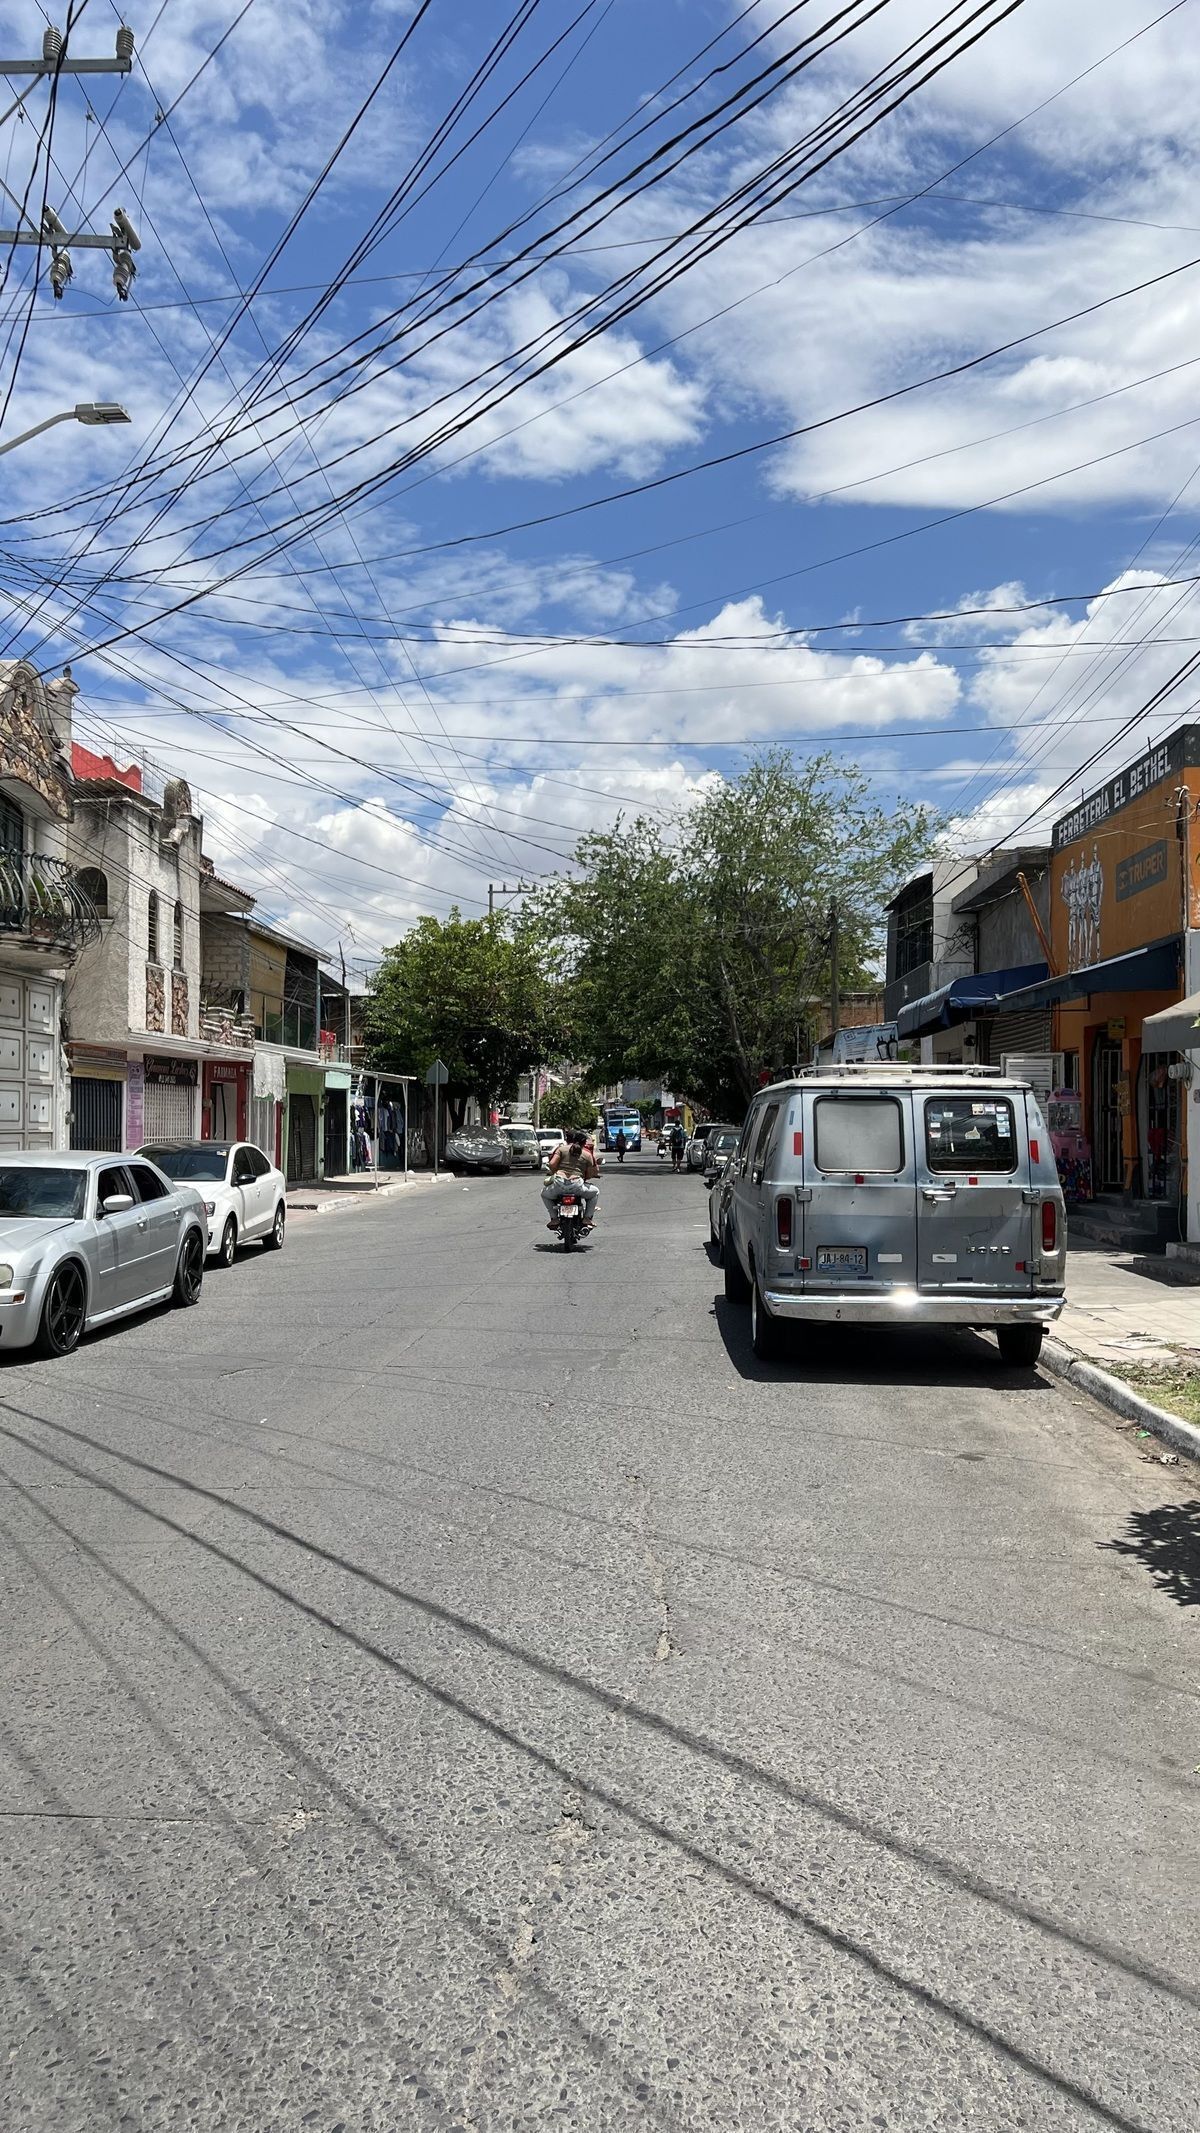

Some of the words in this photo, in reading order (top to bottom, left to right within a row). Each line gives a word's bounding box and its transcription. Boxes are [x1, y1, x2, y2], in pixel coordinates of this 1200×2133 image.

[1113, 779, 1126, 809] EL
[1129, 745, 1172, 798] BETHEL
[1129, 851, 1165, 885] TRUPER
[821, 1252, 864, 1265] JAJ-84-12
